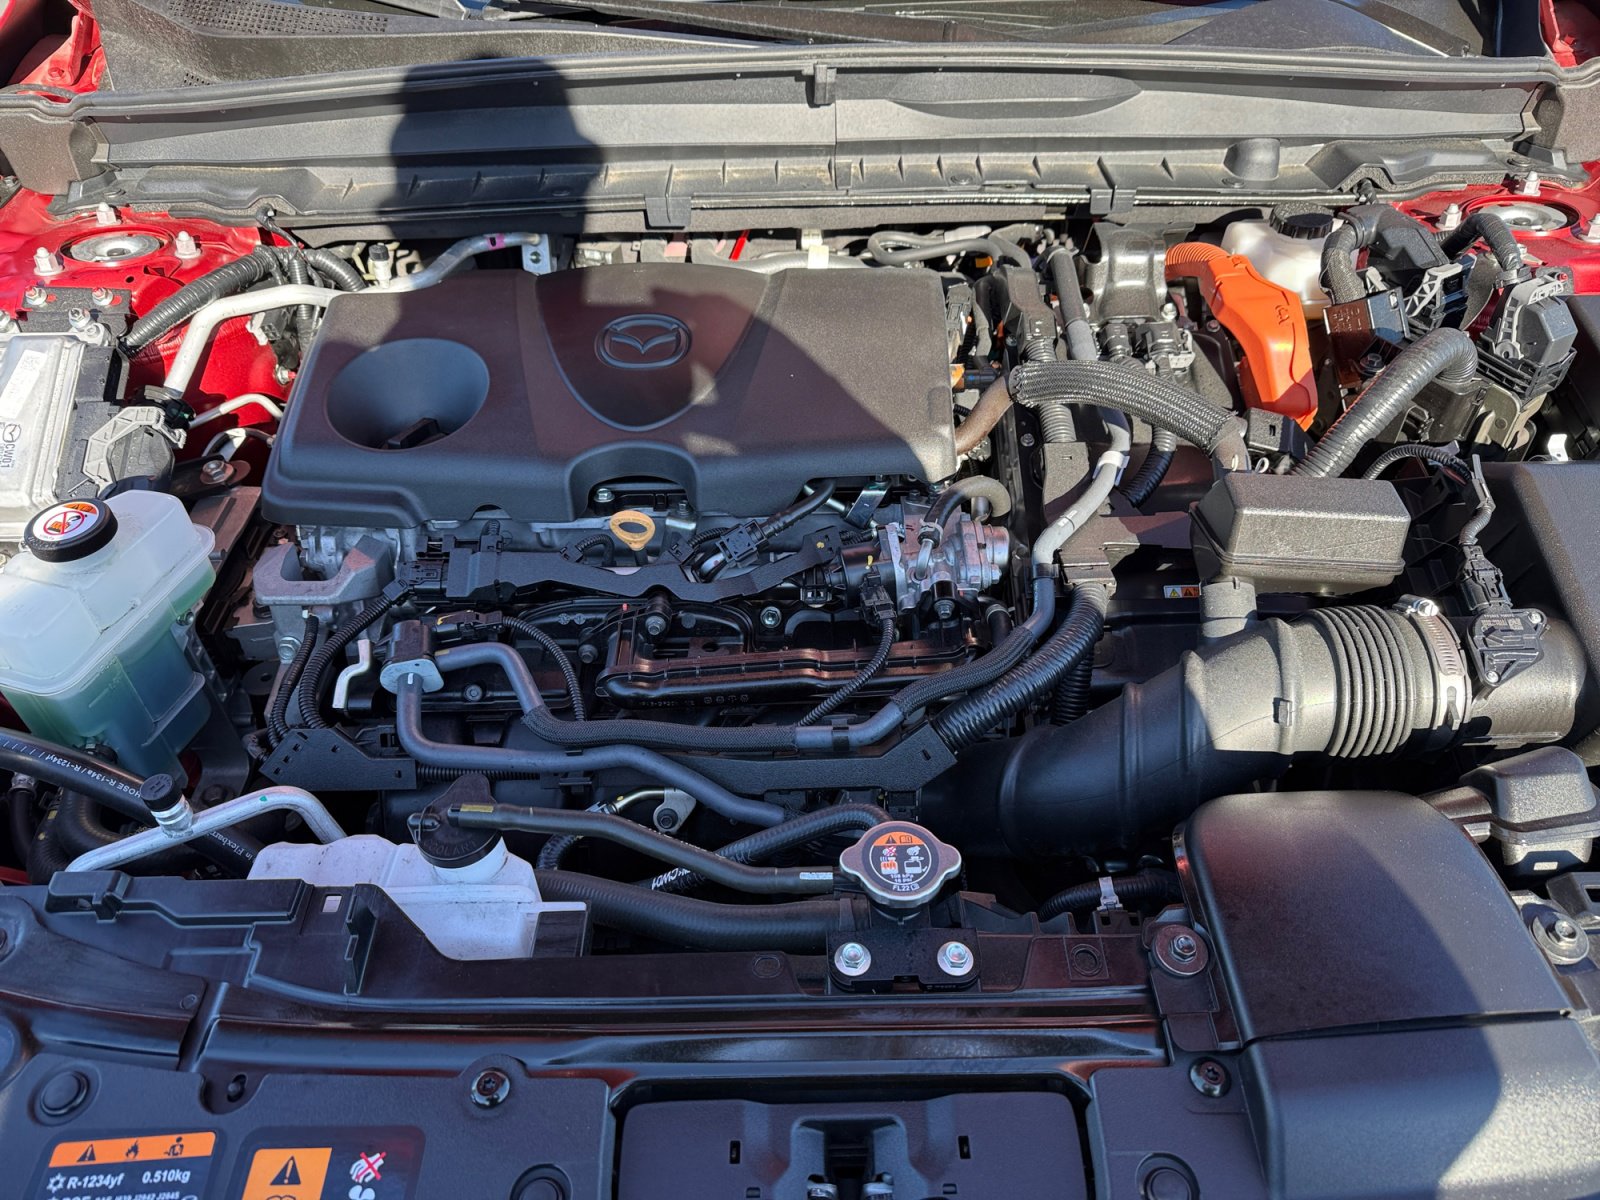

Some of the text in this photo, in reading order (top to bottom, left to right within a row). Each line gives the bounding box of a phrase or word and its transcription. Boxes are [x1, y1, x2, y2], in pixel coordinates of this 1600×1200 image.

[45, 754, 82, 772] R-1234yf
[87, 769, 117, 786] R-134a
[117, 782, 141, 798] HOSE
[206, 830, 245, 856] Flexbarr
[892, 884, 910, 892] FL22
[66, 1169, 191, 1190] R-1234yf 0.510kg
